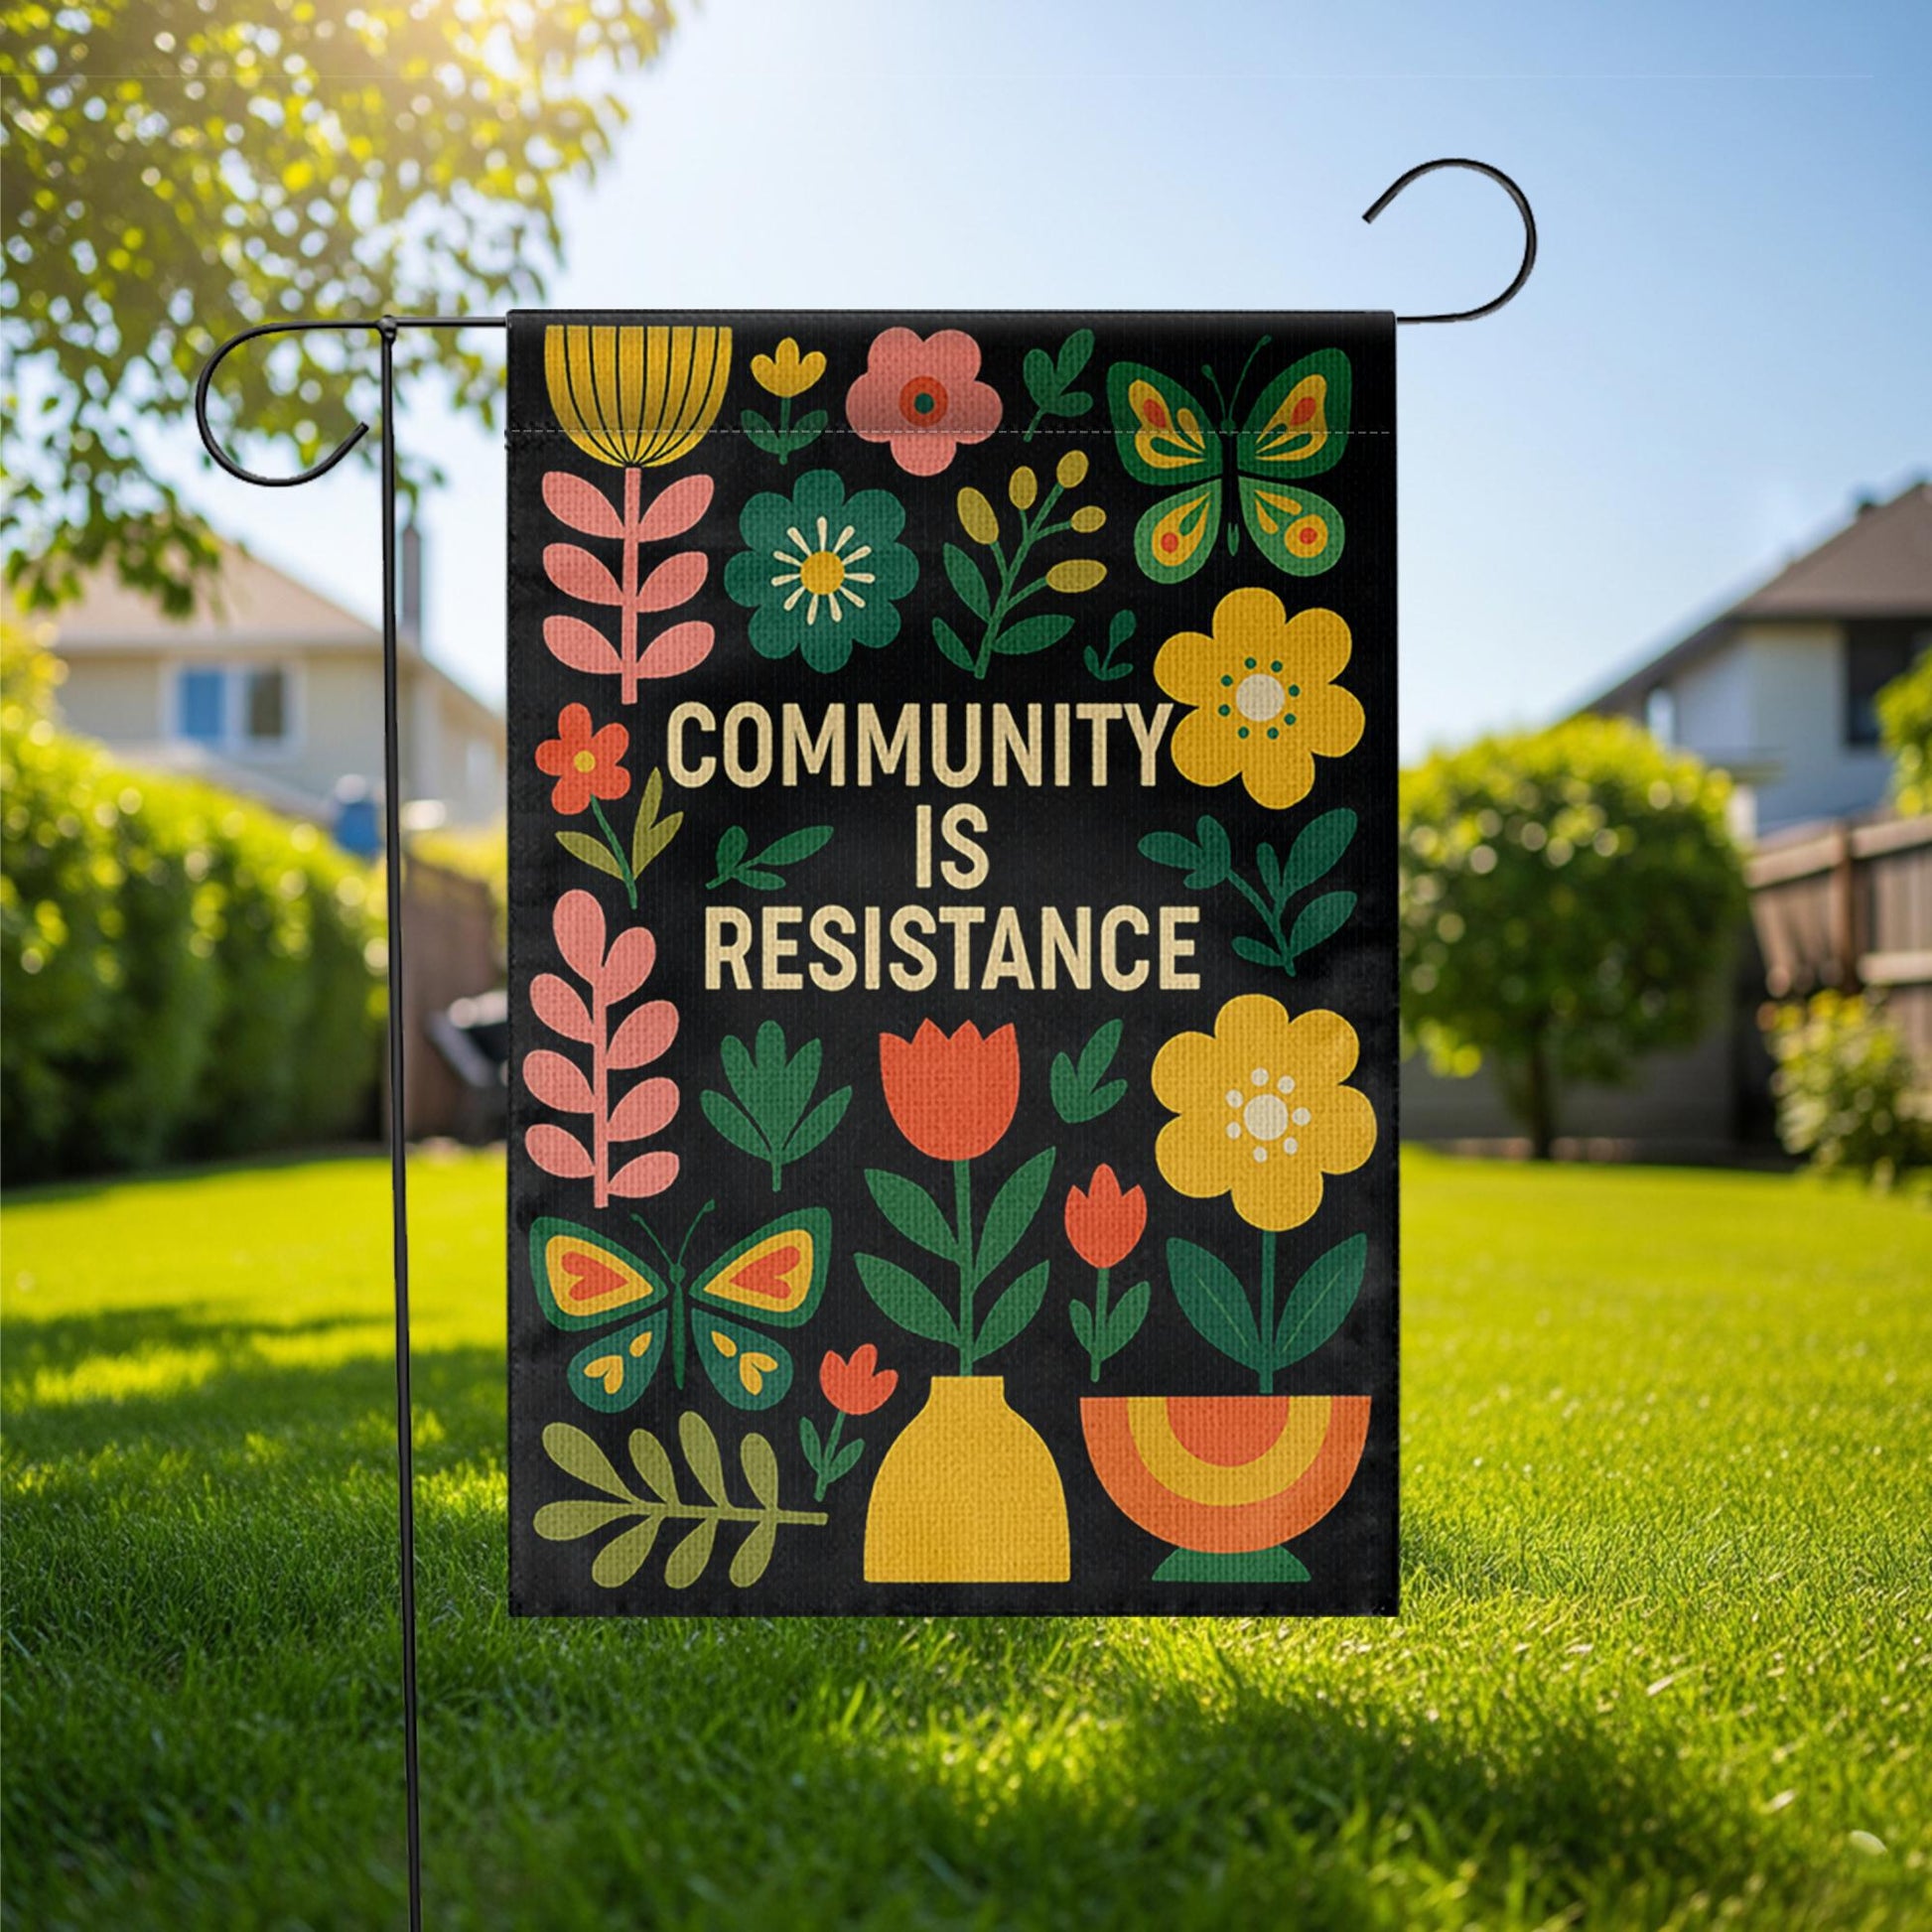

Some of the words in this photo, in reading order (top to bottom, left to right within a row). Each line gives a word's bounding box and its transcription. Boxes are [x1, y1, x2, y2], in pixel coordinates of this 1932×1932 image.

[666, 701, 1173, 788] COMMUNITY
[915, 802, 990, 891] IS
[705, 904, 1201, 991] RESISTANCE
